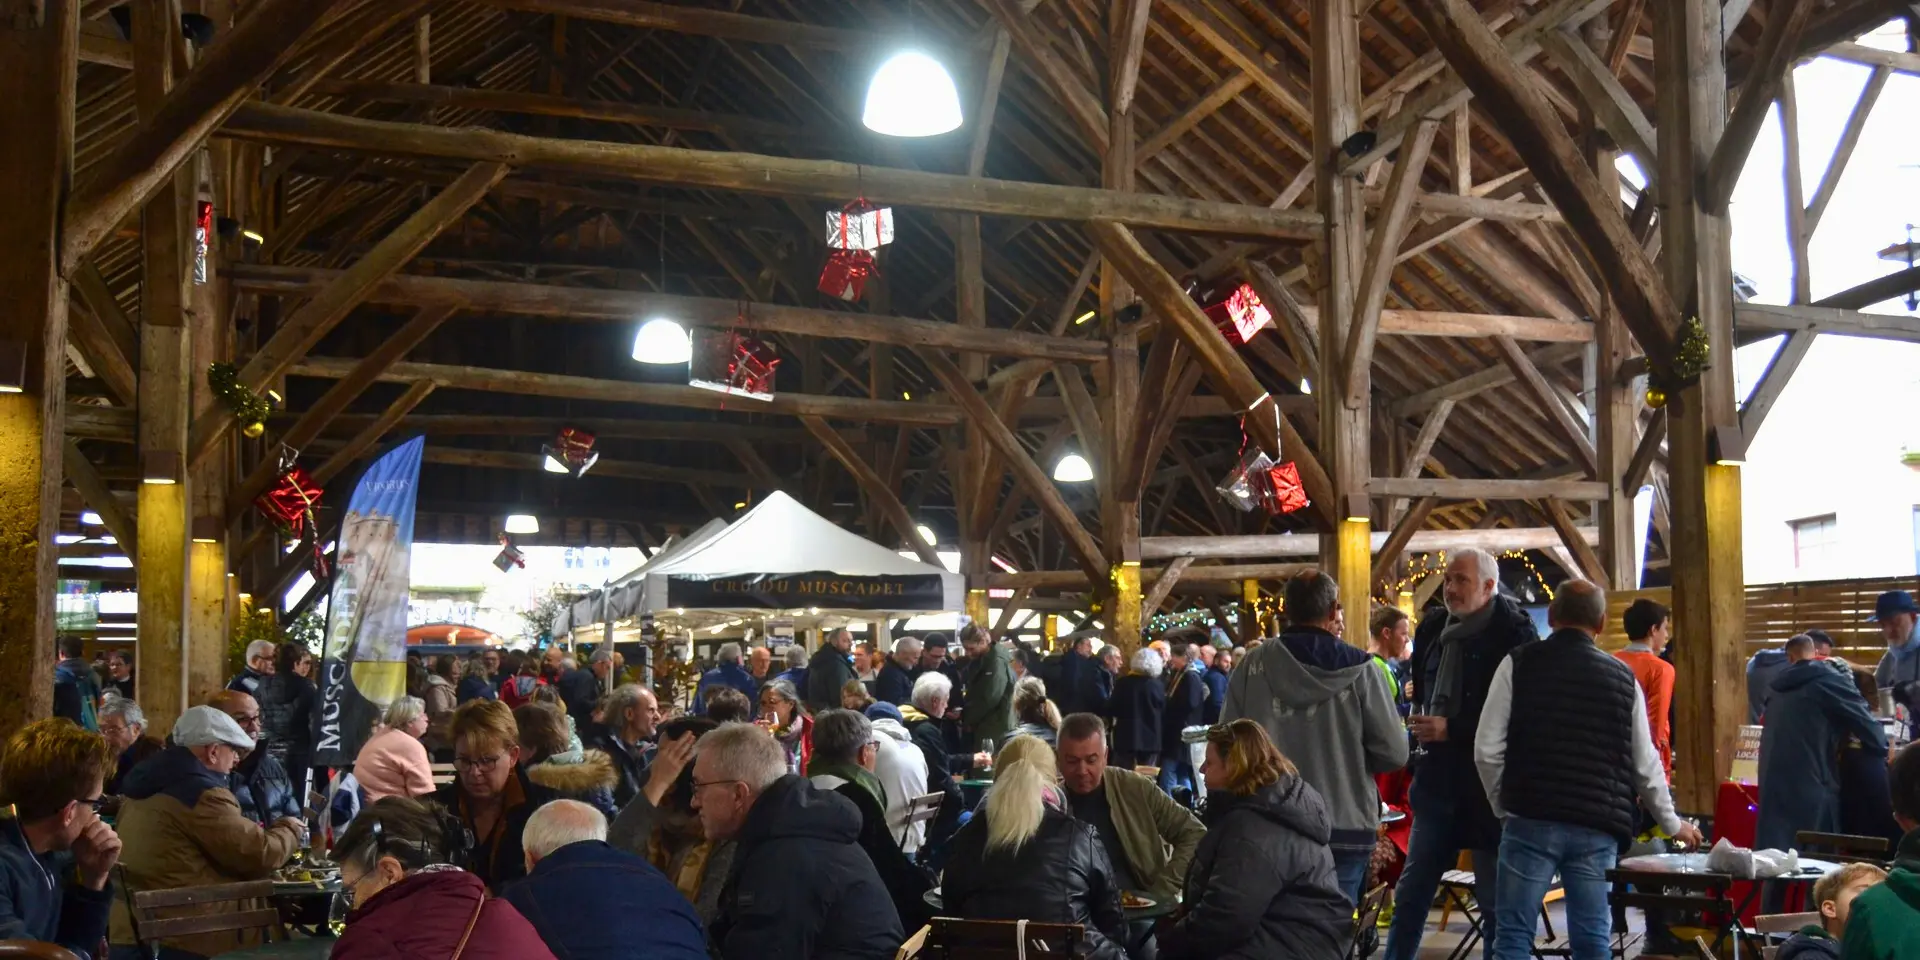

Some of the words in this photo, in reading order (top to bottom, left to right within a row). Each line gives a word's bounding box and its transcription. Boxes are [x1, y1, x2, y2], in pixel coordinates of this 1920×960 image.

[760, 580, 790, 593] DU
[800, 581, 905, 596] MUSCADET
[317, 588, 357, 752] MUSCADET
